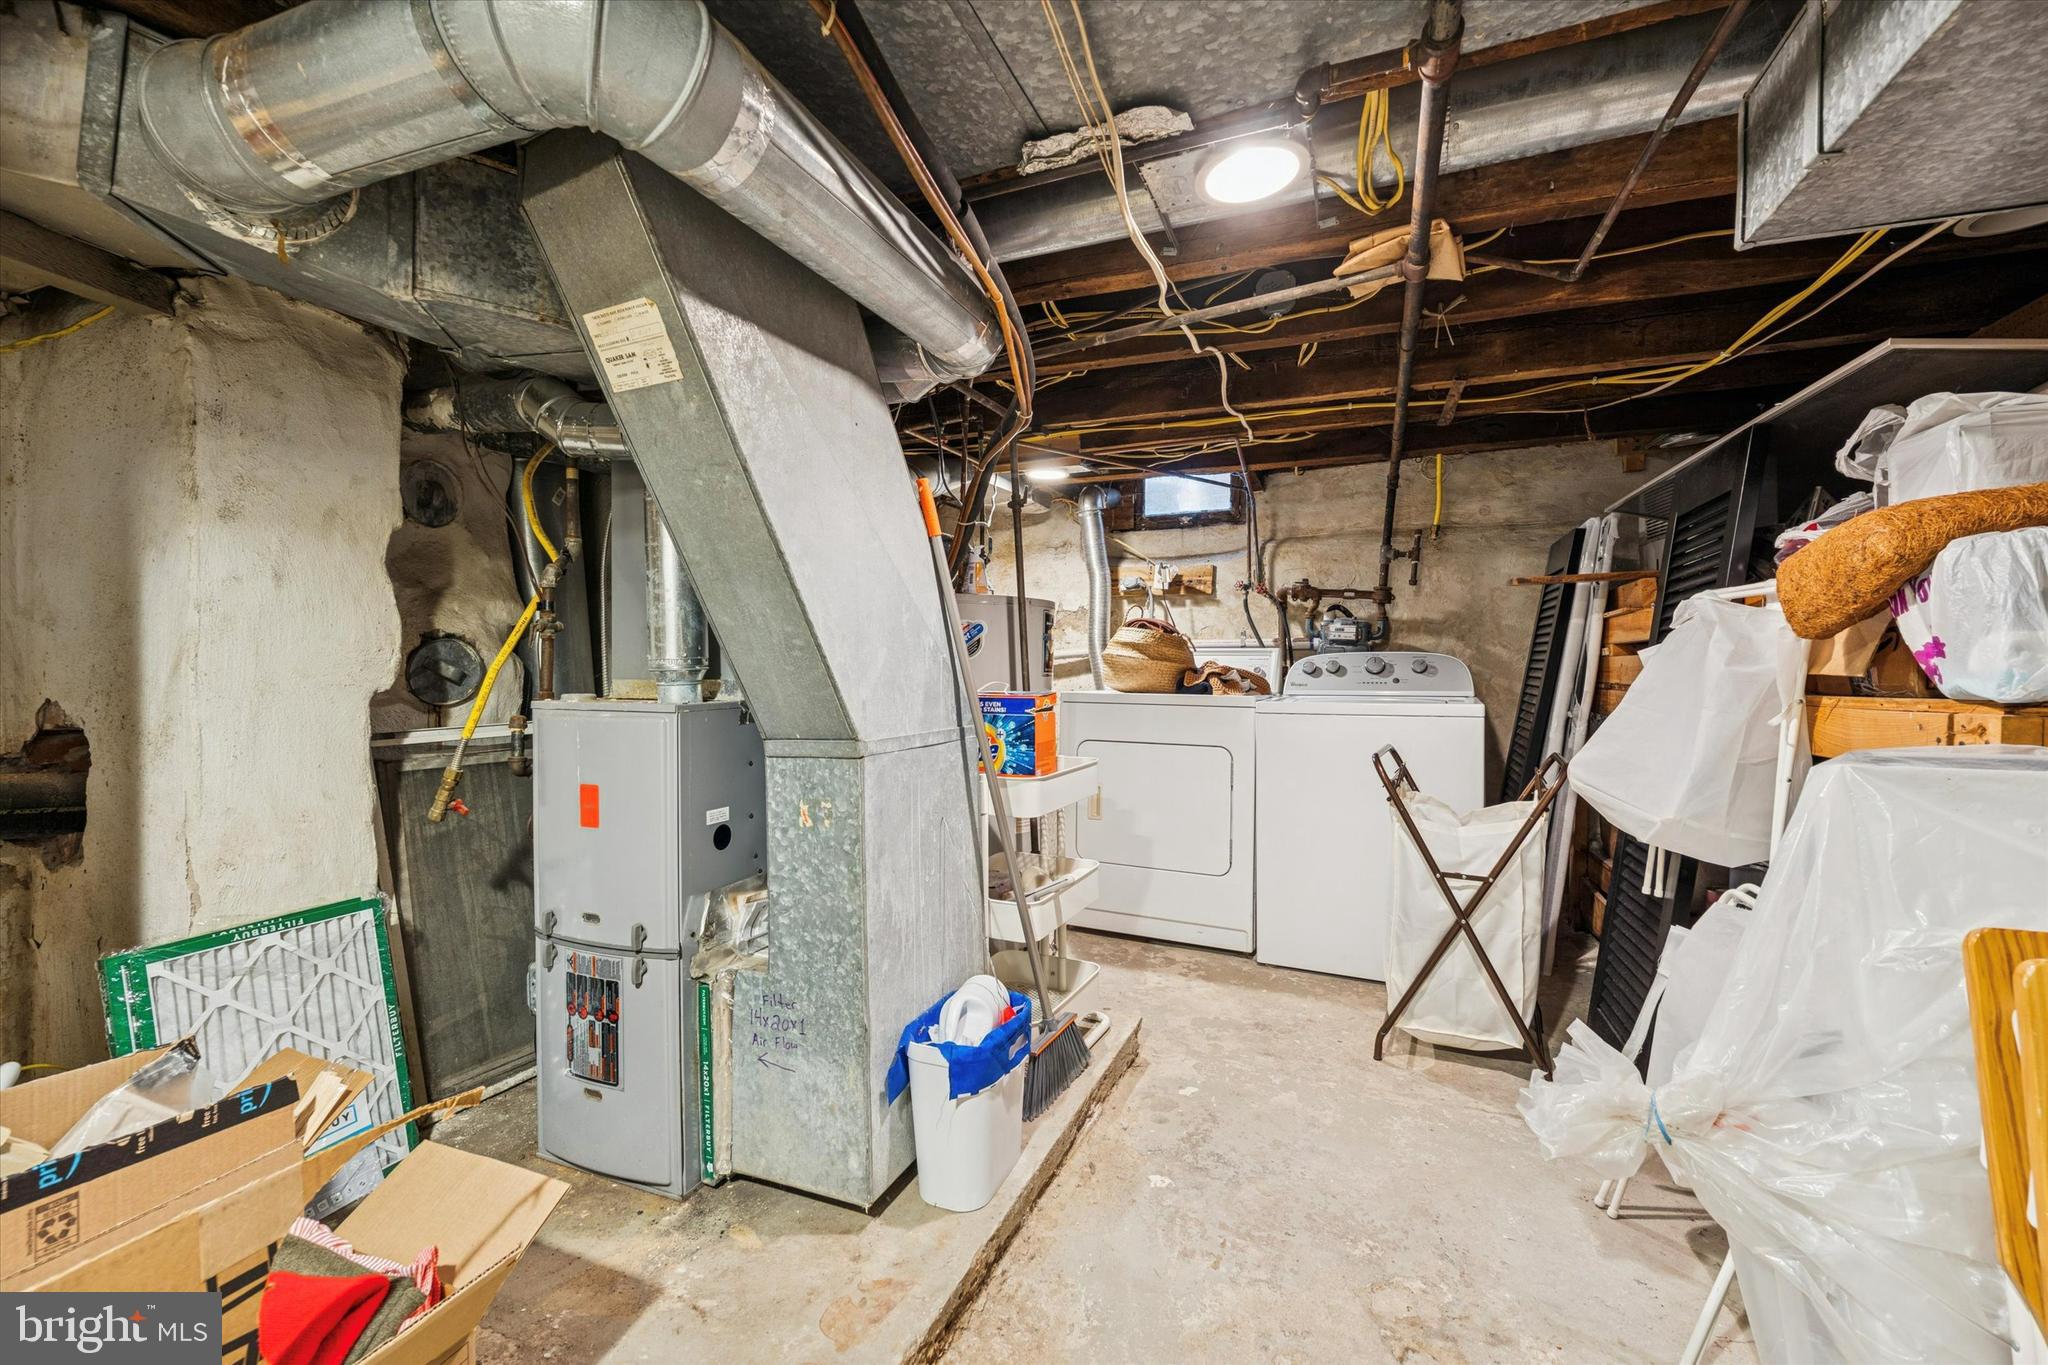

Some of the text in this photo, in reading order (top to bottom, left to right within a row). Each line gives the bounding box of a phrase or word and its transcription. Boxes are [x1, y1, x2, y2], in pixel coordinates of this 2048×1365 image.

[233, 918, 304, 941] FILTERBUY
[763, 994, 797, 1009] Filter
[388, 1005, 403, 1058] FILTERBUY
[751, 1008, 806, 1035] 14x20x1
[752, 1033, 798, 1050] Air Flow
